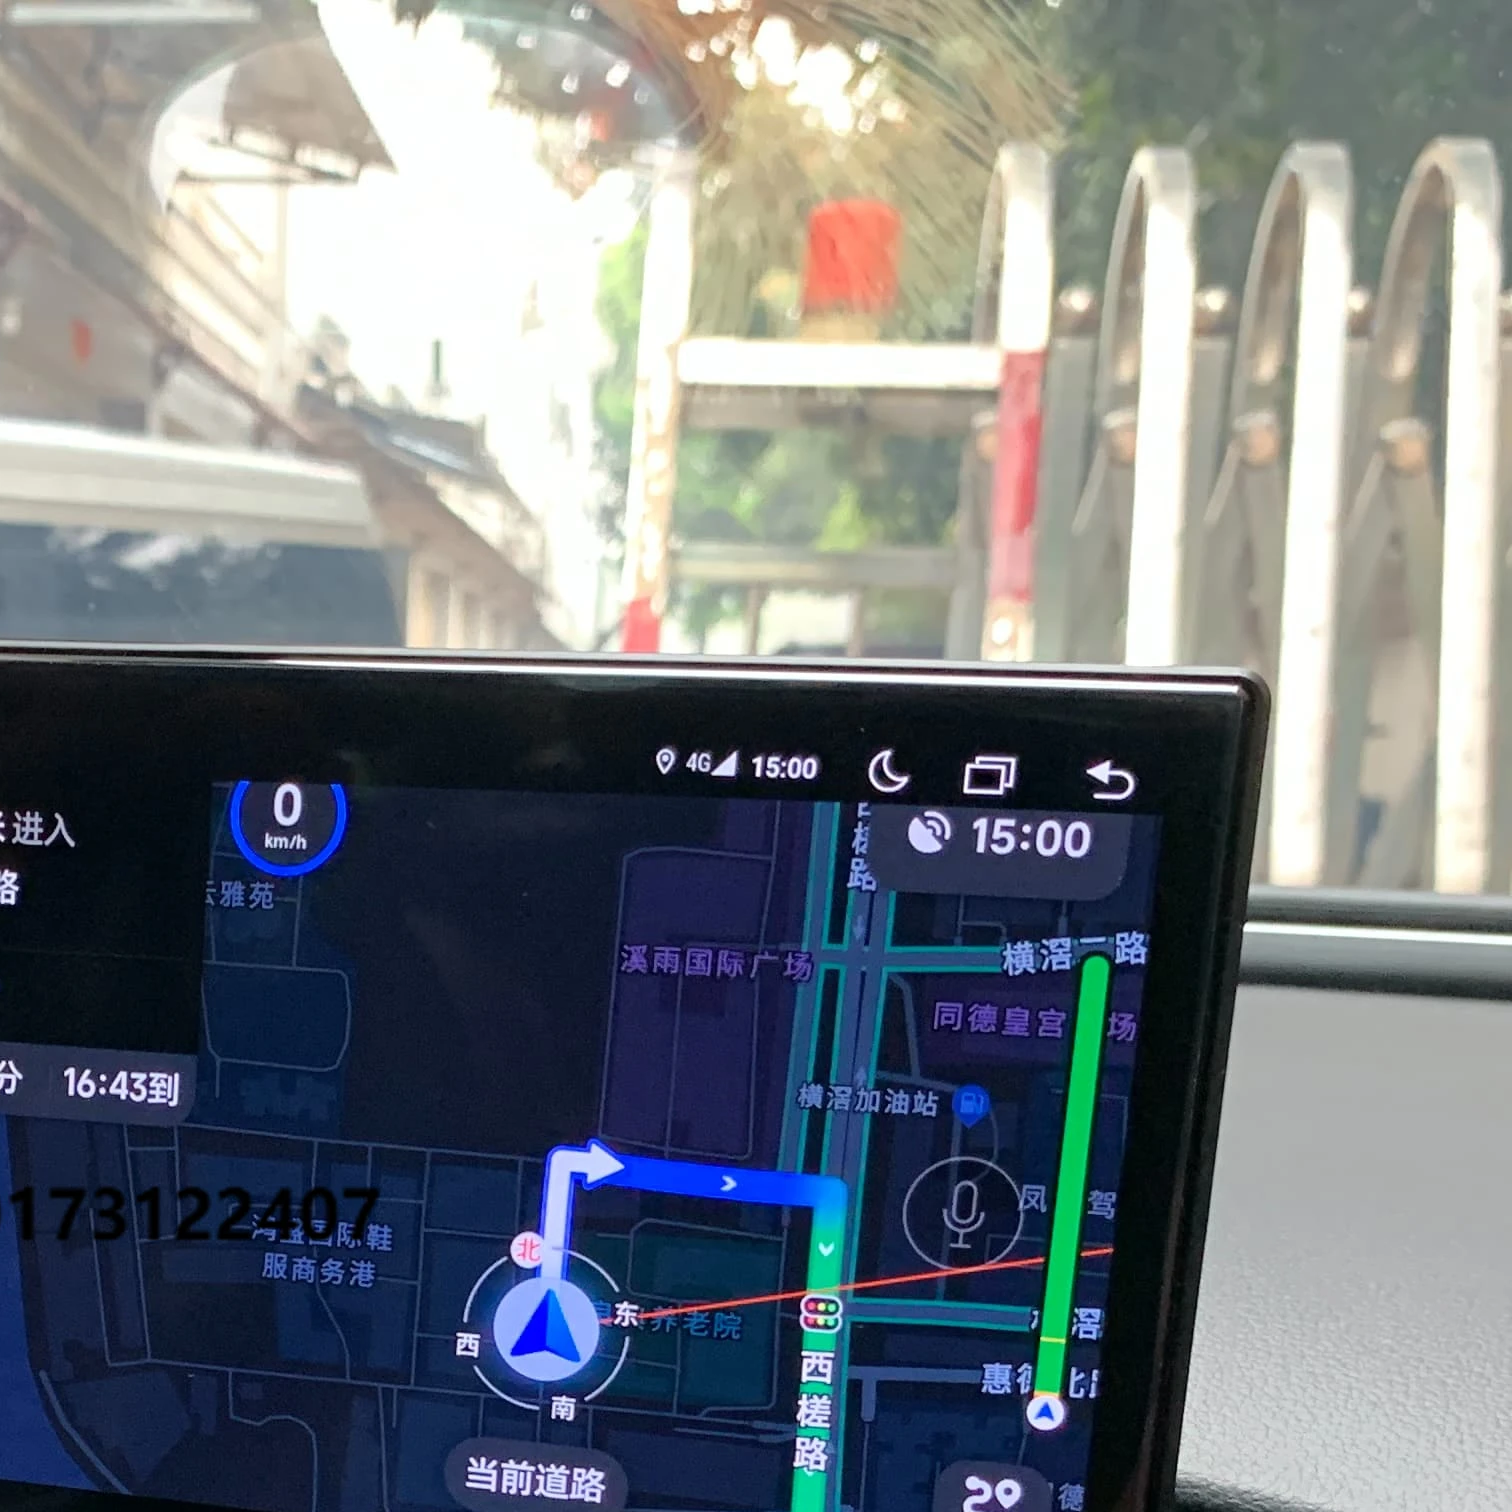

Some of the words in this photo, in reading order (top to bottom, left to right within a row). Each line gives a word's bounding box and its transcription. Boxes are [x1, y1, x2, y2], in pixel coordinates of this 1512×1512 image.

[686, 752, 711, 773] 4G
[752, 756, 818, 780] 15:00
[273, 782, 303, 827] 0
[264, 832, 307, 850] km/h
[972, 815, 1092, 858] 15:00
[1001, 929, 1149, 977] 横滘一路
[933, 1001, 1139, 1043] 同德皇宫场
[63, 1067, 181, 1107] 16:43到
[797, 1082, 940, 1118] 横滘加油站
[517, 1238, 541, 1262] 北
[261, 1252, 378, 1289] 服商务港
[614, 1301, 639, 1327] 东
[455, 1331, 481, 1358] 西
[550, 1395, 576, 1421] 南
[792, 1350, 835, 1472] 西槎路
[464, 1456, 607, 1504] 当前道路
